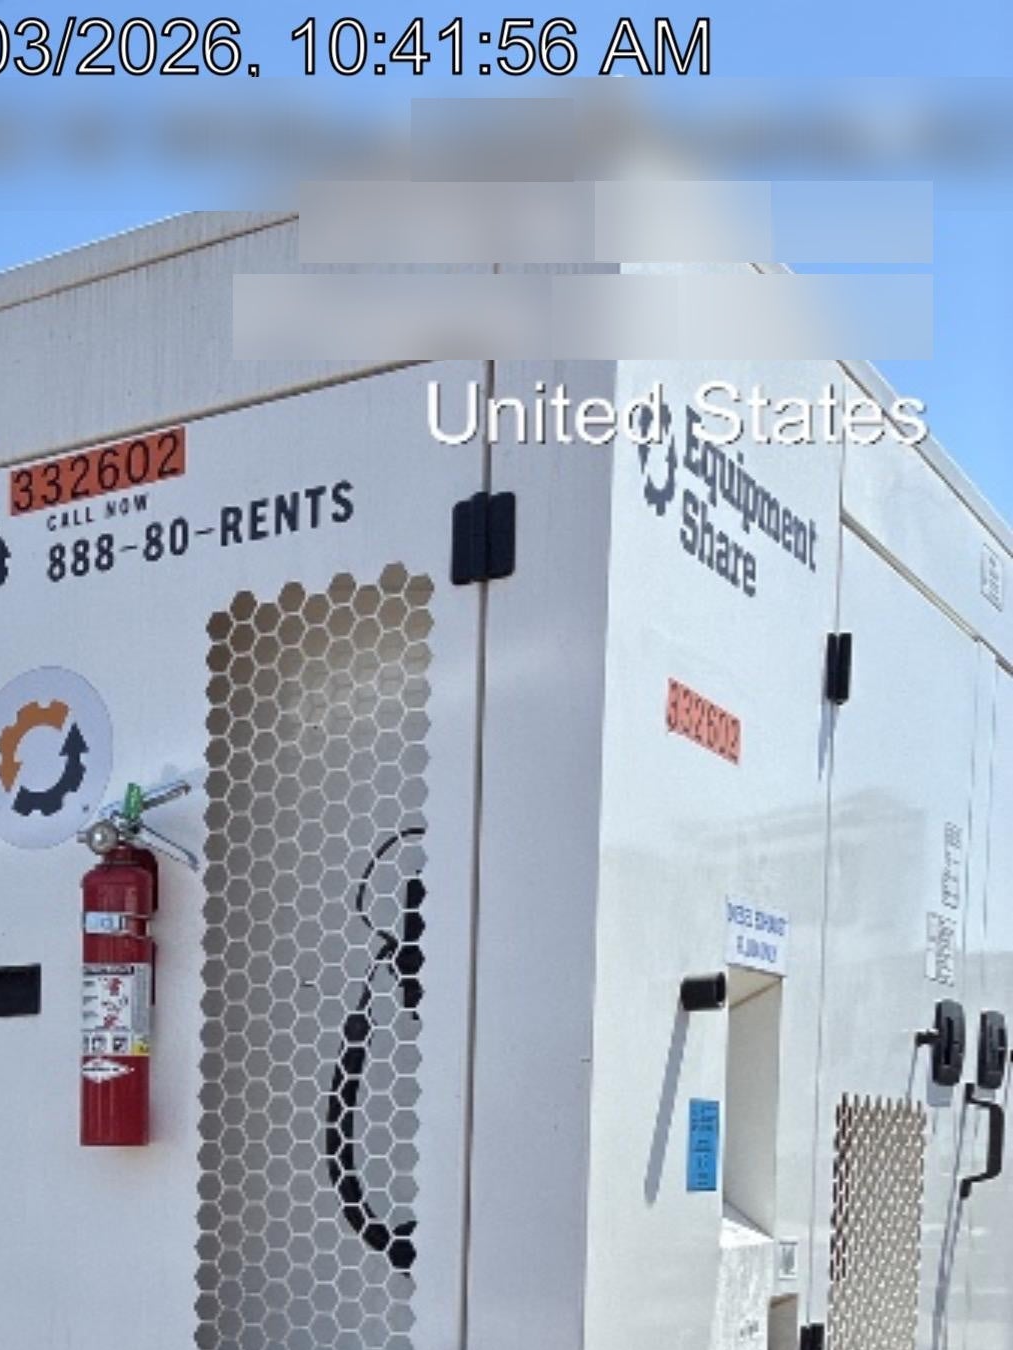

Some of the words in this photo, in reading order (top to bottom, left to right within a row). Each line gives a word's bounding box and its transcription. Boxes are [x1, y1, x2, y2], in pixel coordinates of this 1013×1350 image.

[13, 432, 182, 512] 332602
[47, 506, 95, 532] CALL
[105, 493, 149, 518] NOW
[683, 404, 818, 573] Equipment
[47, 479, 354, 582] 888-80-RENTS
[680, 488, 757, 598] Share
[667, 680, 740, 765] 332602
